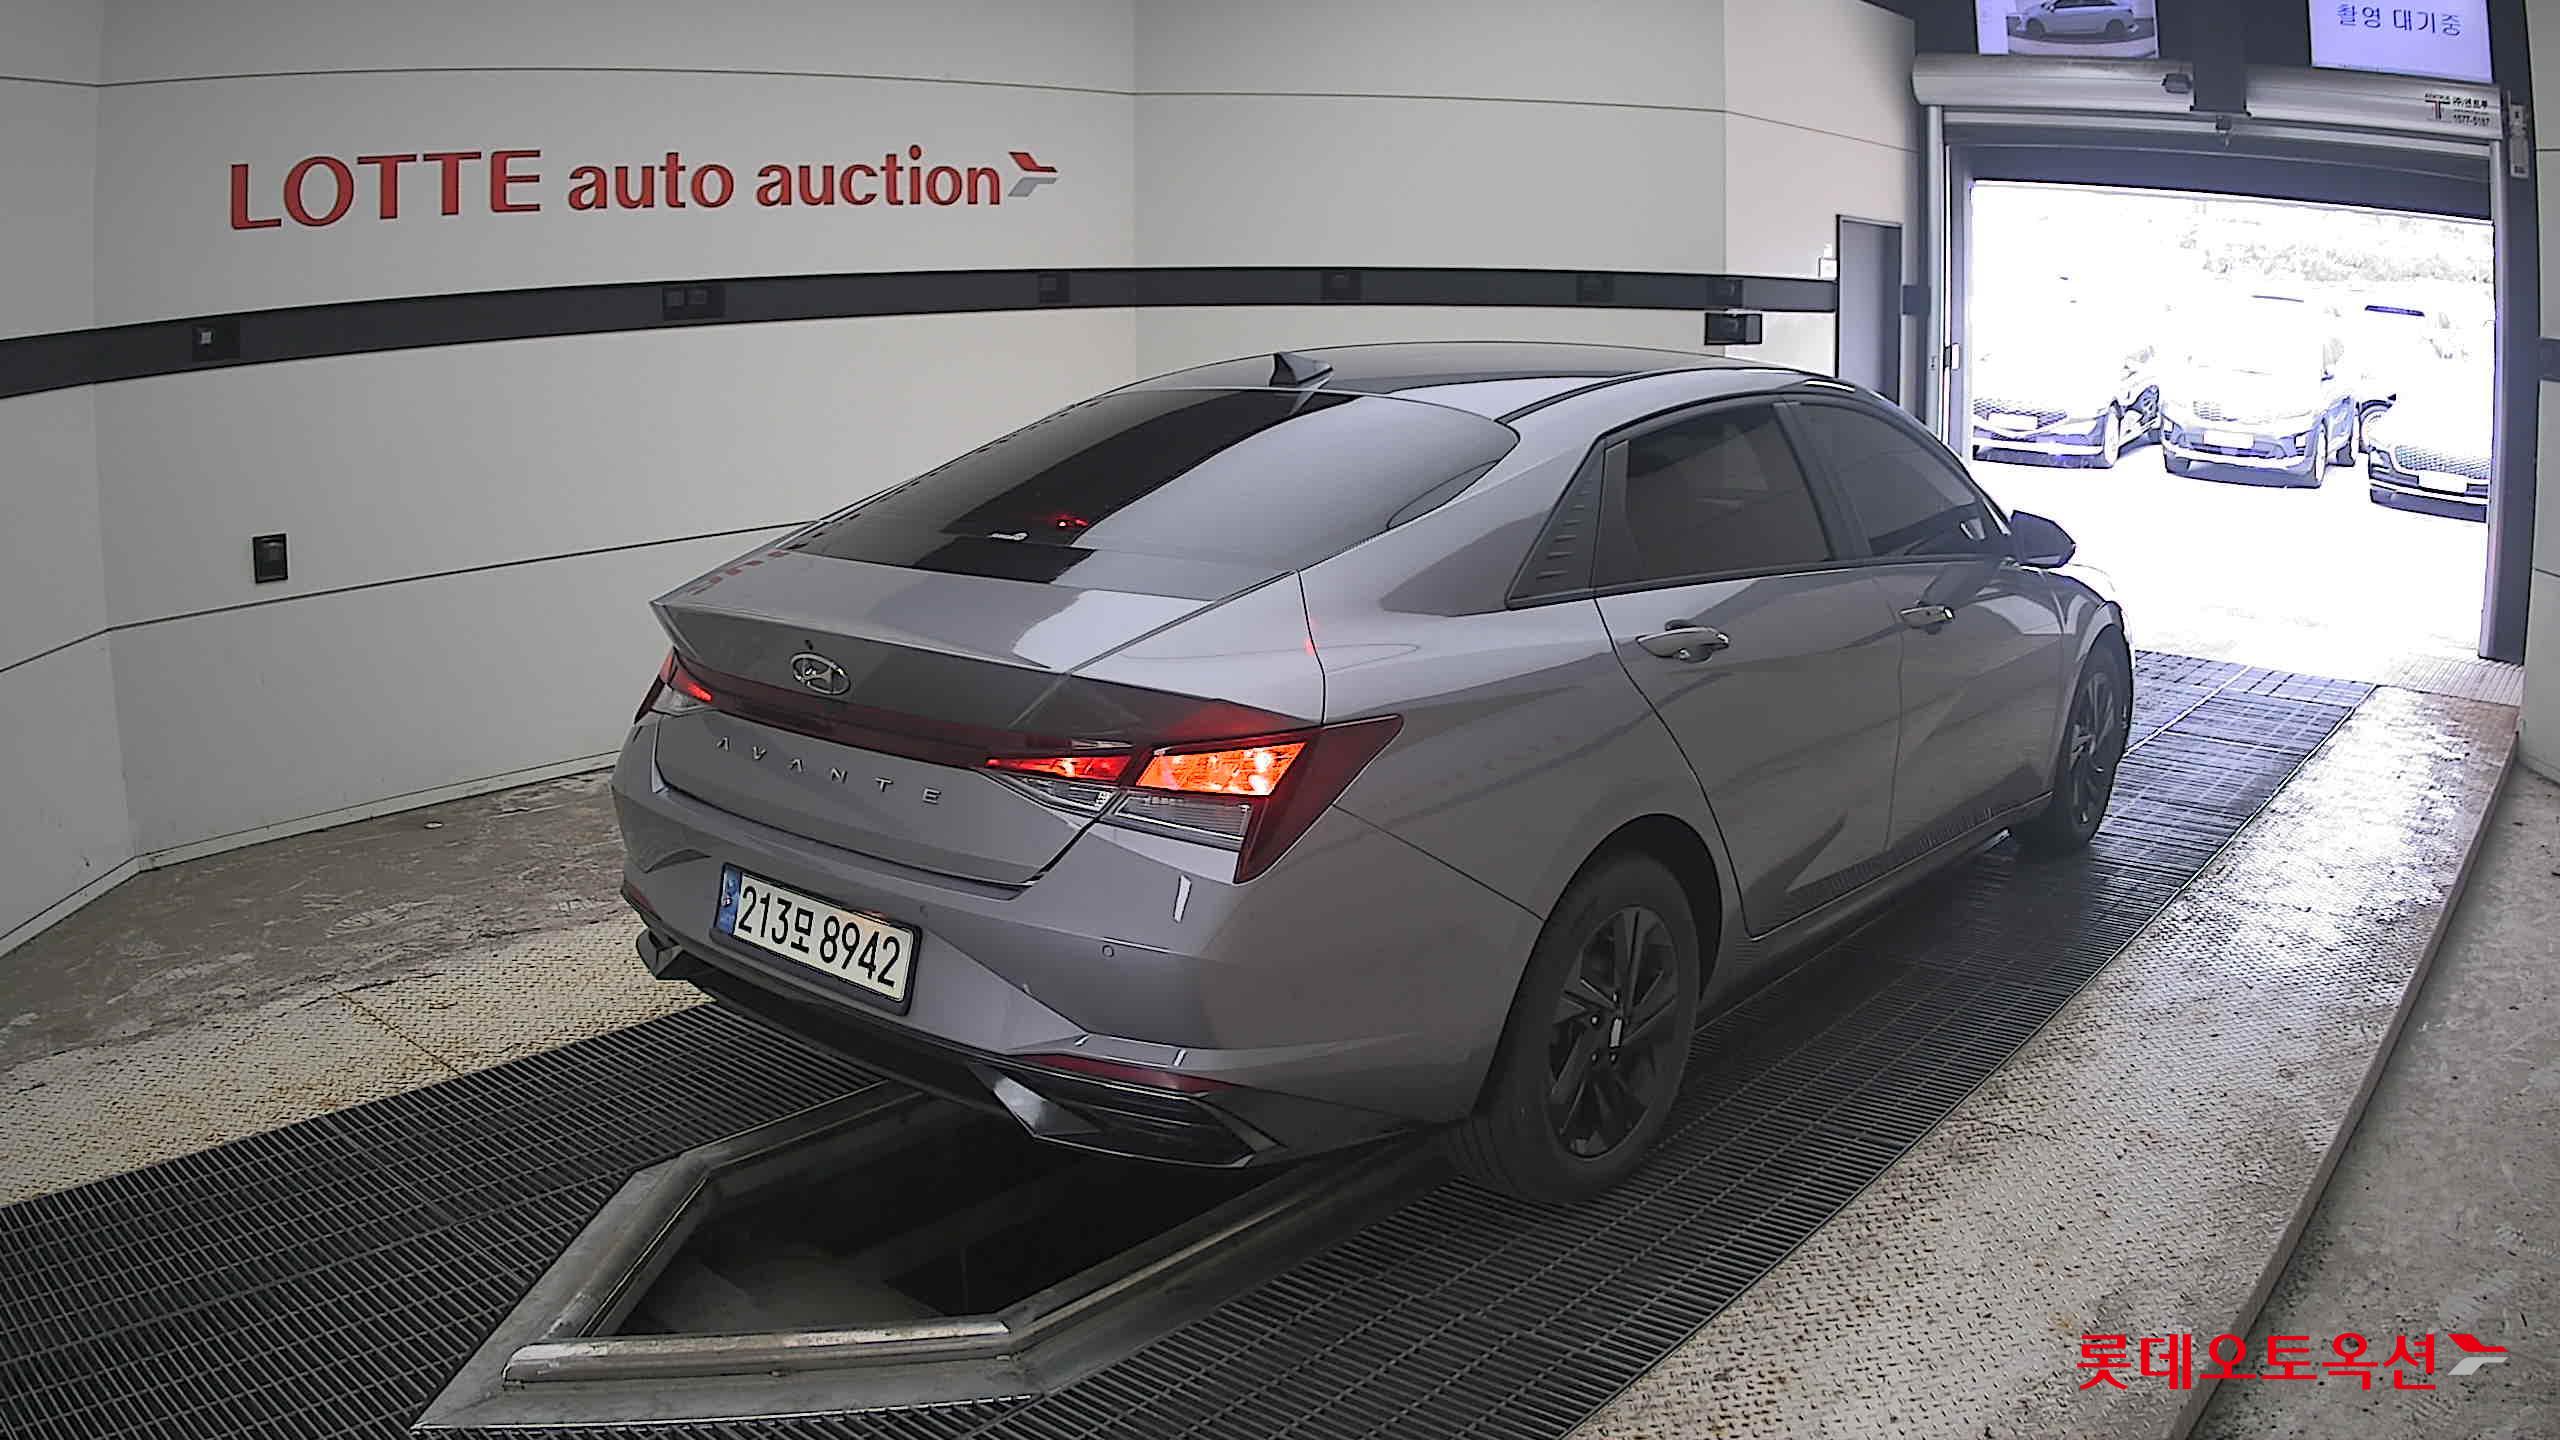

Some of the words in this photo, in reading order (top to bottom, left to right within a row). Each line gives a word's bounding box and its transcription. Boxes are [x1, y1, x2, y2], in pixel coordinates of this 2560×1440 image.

[2393, 8, 2461, 36] 대기중
[230, 149, 541, 230] LOTTE
[567, 151, 734, 209] auto
[756, 144, 1001, 208] auction
[716, 735, 942, 805] AVANTE
[738, 885, 814, 954] 213모
[819, 915, 901, 988] 8942
